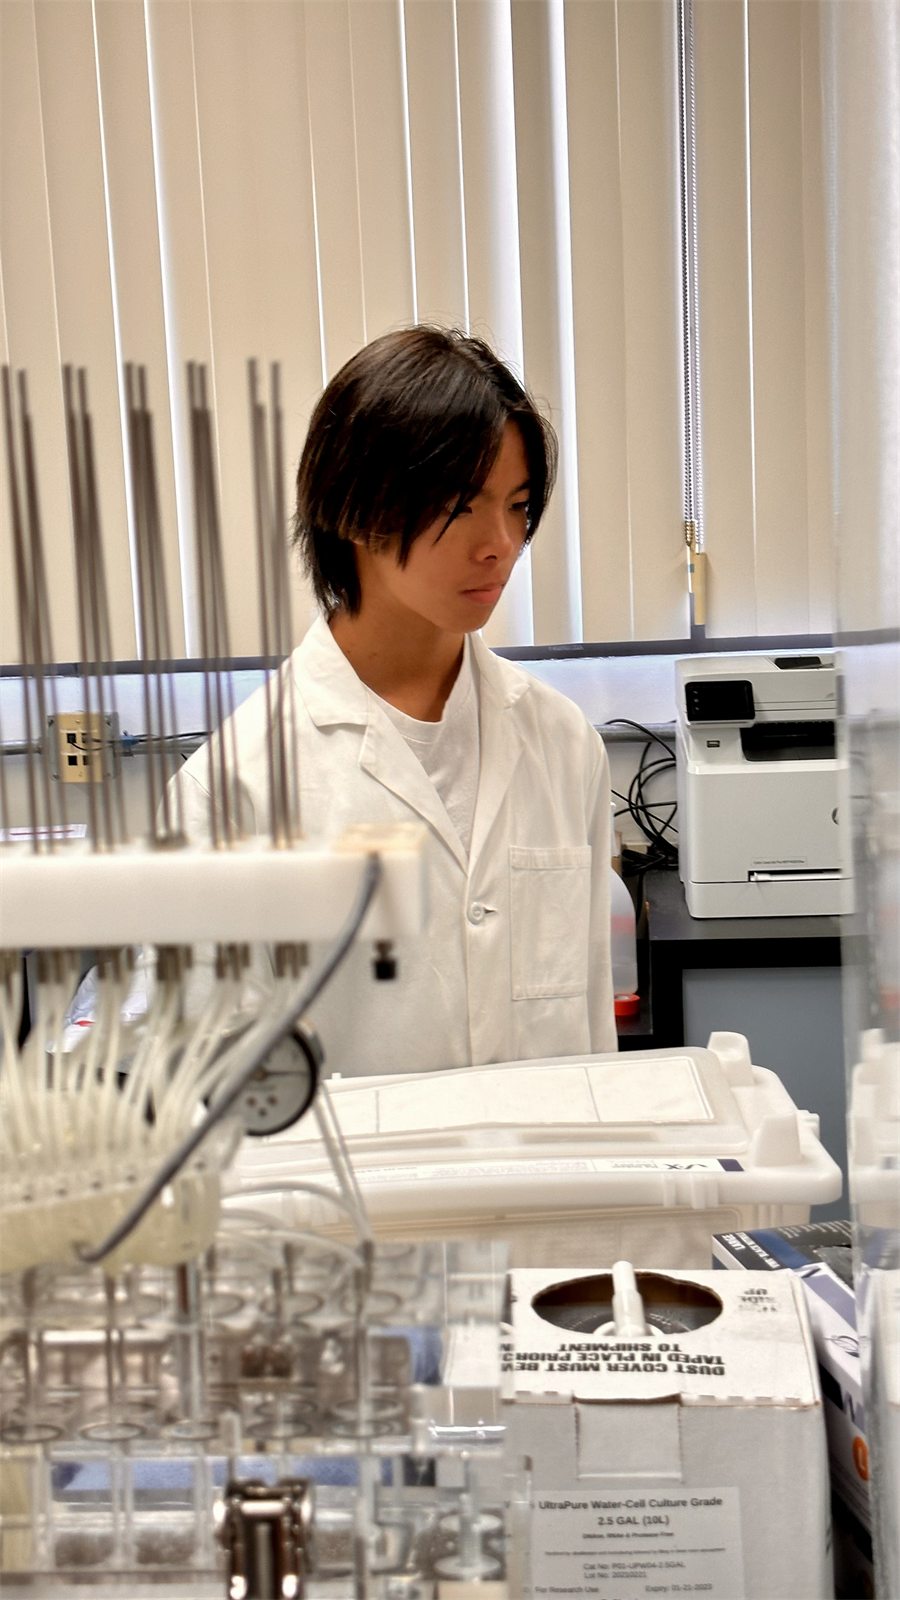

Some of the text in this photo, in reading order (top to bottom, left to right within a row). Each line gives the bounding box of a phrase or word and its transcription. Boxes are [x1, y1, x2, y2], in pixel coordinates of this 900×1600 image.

[558, 1343, 682, 1353] TO SHIPMENT
[515, 1352, 725, 1365] TAPED IN PLACE PRIOR
[545, 1362, 600, 1372] MUST
[607, 1362, 668, 1373] COVER
[674, 1363, 725, 1376] DUST
[539, 1497, 723, 1510] UltraPure Water-Cell Culture Grade
[598, 1515, 669, 1526] 2.5 GAL (10L)
